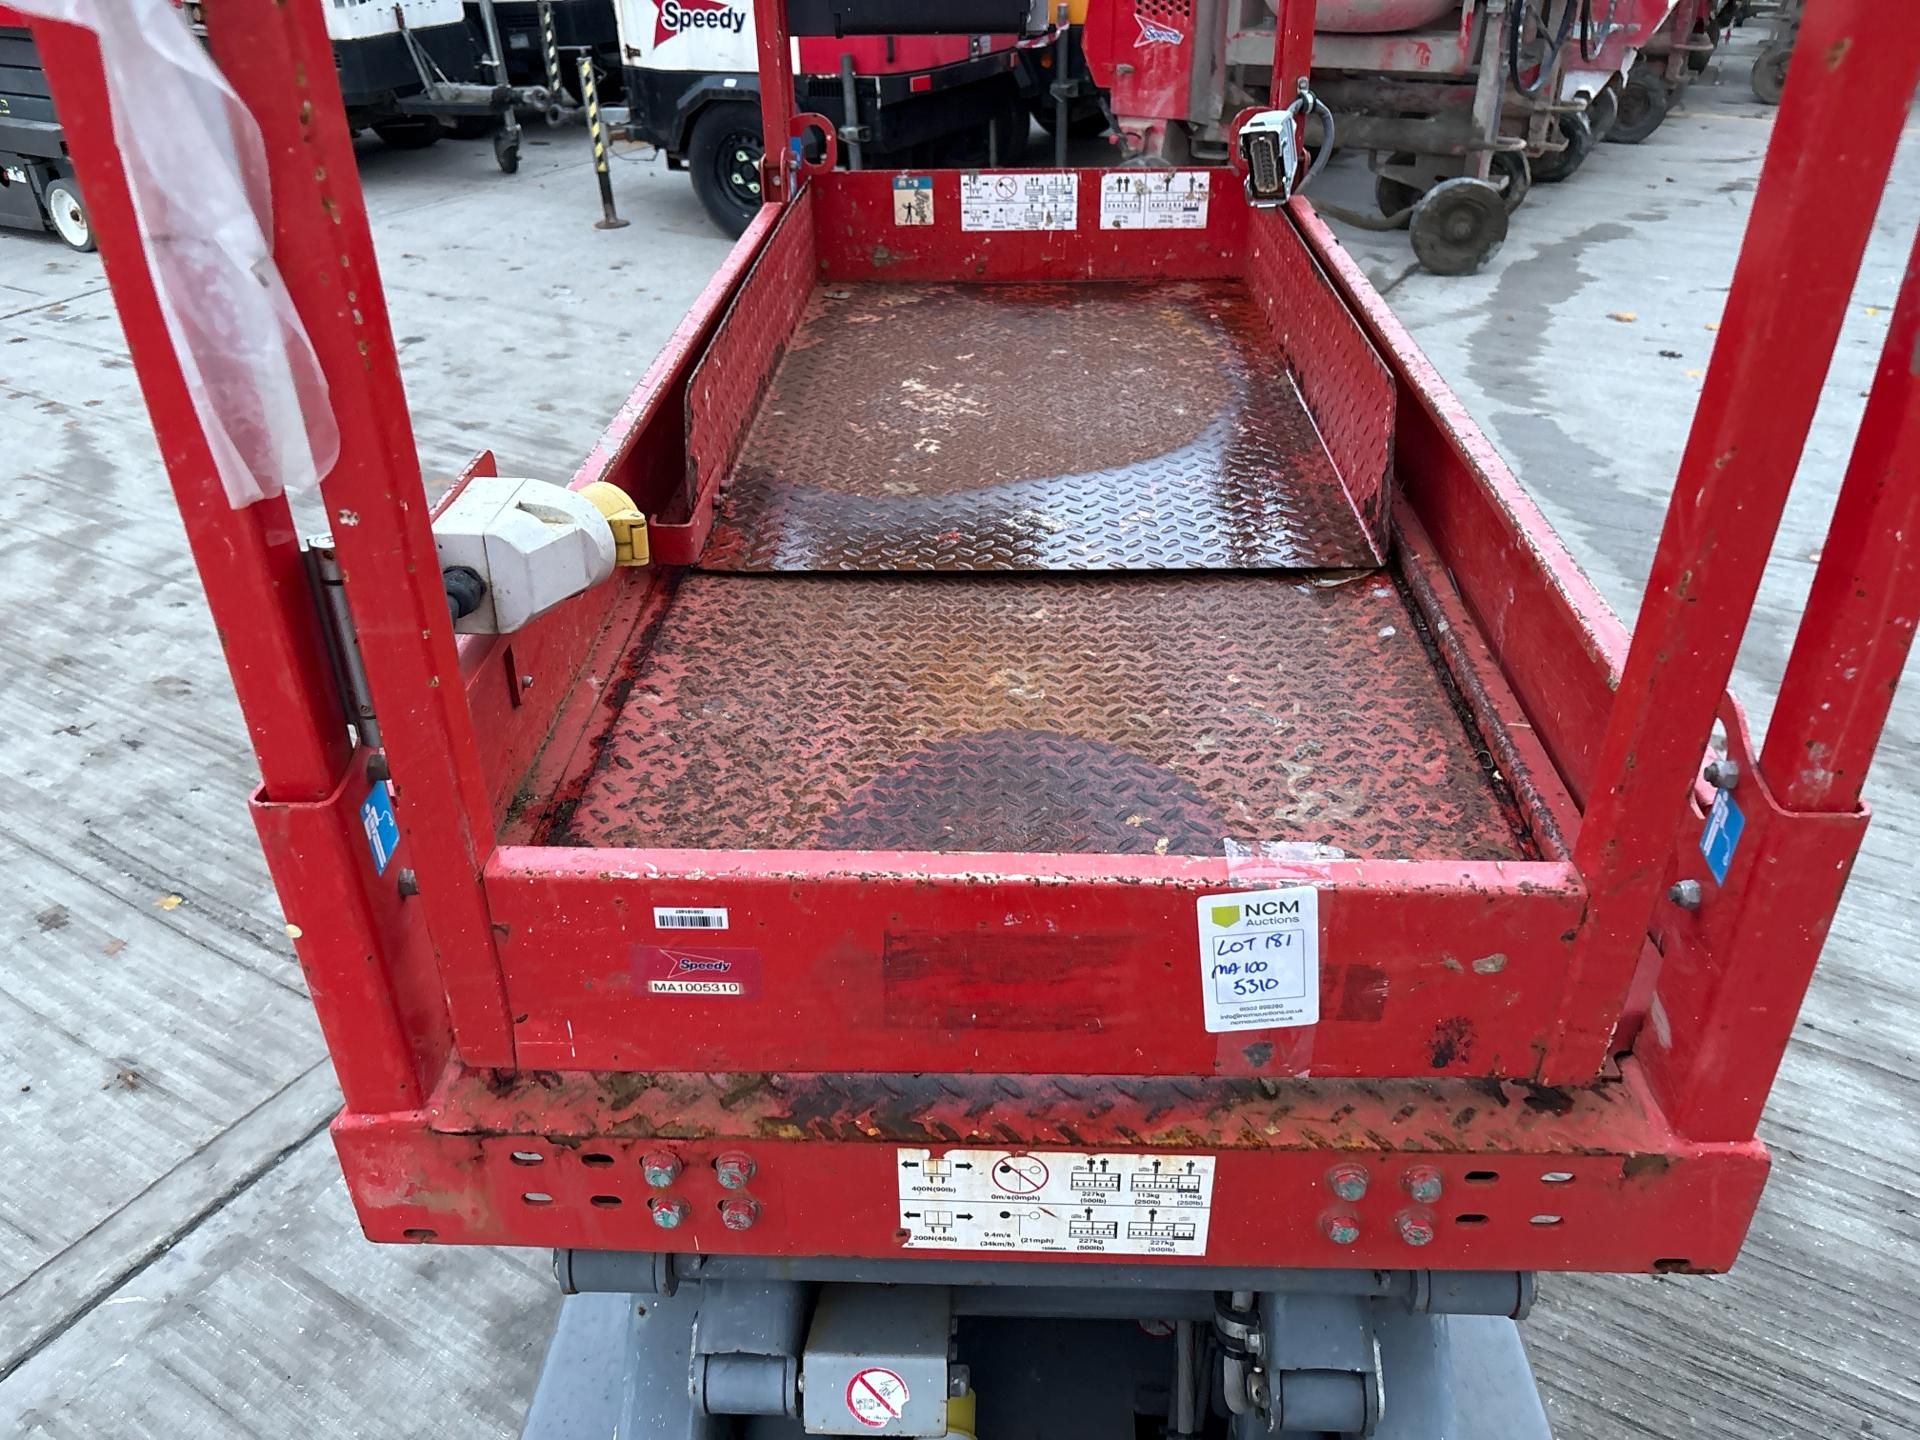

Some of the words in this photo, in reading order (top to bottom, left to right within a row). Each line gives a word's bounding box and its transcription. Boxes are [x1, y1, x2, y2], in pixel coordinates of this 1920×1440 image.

[664, 2, 746, 33] Speedy
[1245, 900, 1299, 917] NCM
[1246, 916, 1300, 927] Auctions
[1217, 937, 1257, 956] LOT
[1265, 933, 1291, 950] 181
[680, 959, 731, 972] Speedy
[654, 983, 738, 993] MA1005310
[1233, 978, 1279, 996] 5310
[1081, 1191, 1106, 1199] 227kg
[980, 1240, 1015, 1248] (34km/h)
[1078, 1238, 1103, 1246] 227kg
[1150, 1240, 1175, 1248] 227kg
